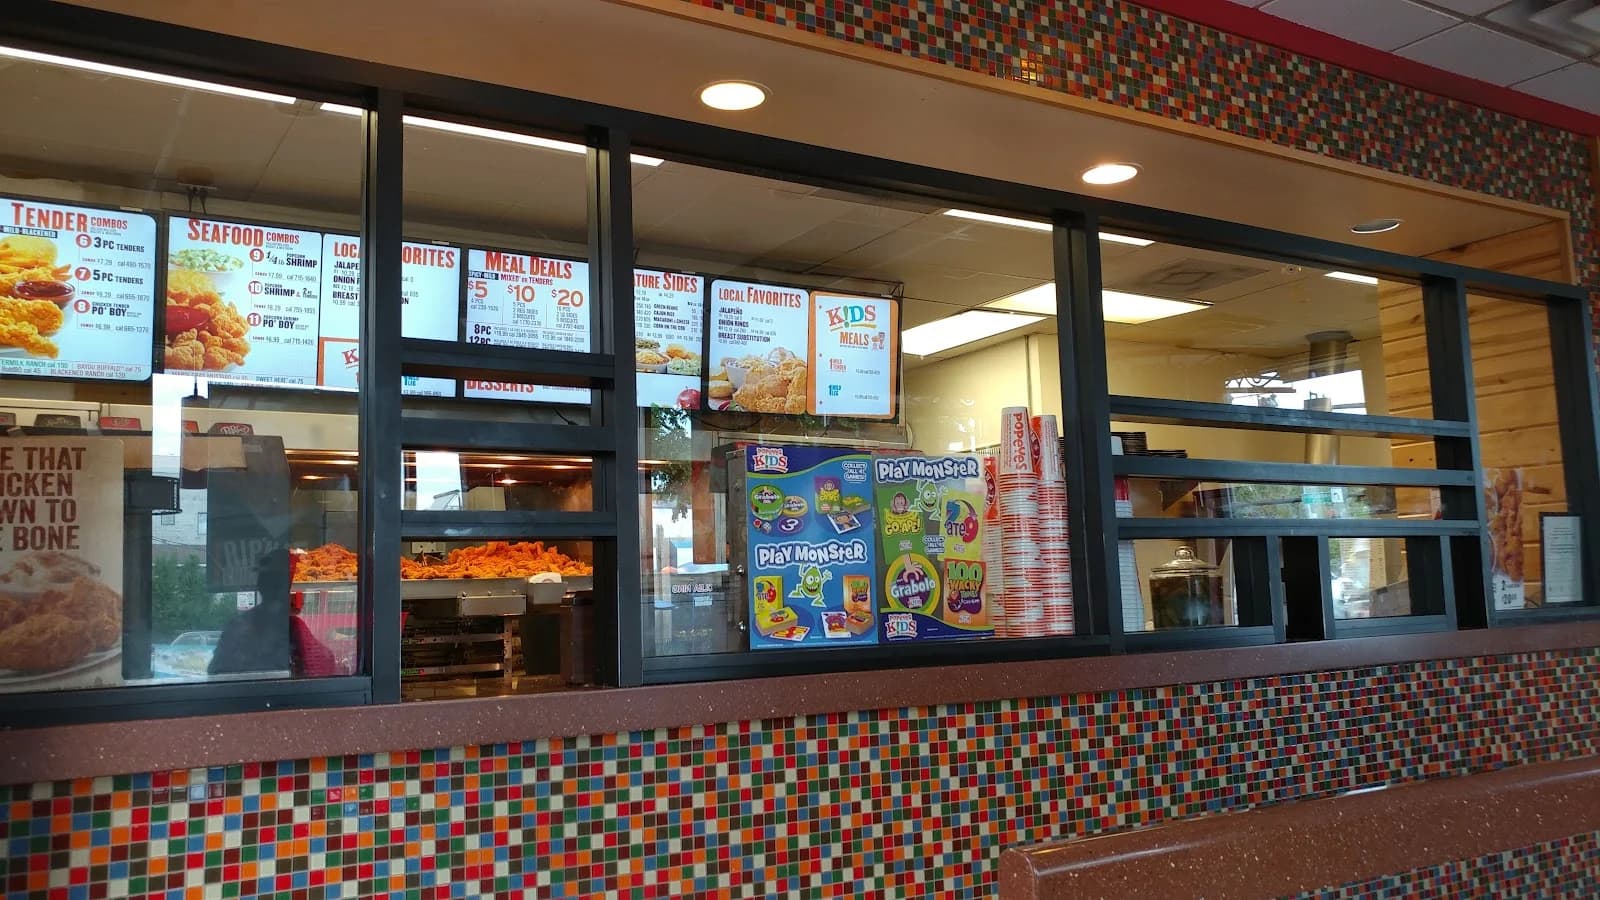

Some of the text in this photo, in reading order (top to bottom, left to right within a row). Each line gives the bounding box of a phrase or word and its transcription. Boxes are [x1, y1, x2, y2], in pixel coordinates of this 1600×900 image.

[11, 202, 88, 233] TENDER
[91, 216, 128, 230] COMBOS
[188, 218, 264, 247] SEAFOOD
[266, 231, 300, 245] COMBOS
[116, 243, 145, 253] TENDERS
[286, 257, 318, 269] SHRIMP
[485, 250, 572, 280] MEAL DEALS
[115, 276, 144, 285] TENDERS
[333, 275, 356, 285] ONION
[500, 273, 520, 282] MIXED
[529, 276, 553, 286] TENDERS
[662, 271, 698, 293] SIDES
[249, 282, 261, 294] 10
[264, 286, 295, 297] SHRIMP
[332, 291, 360, 300] BREAST
[468, 280, 584, 308] $5 $10 $20
[719, 285, 801, 308] LOCAL FAVORITES
[109, 307, 127, 317] BOY
[278, 320, 295, 330] BOY
[718, 332, 771, 342] BREAST SUBSTITUTION
[840, 331, 869, 346] MEALS
[1012, 412, 1027, 471] popeyes
[23, 447, 87, 471] THAT
[45, 499, 77, 523] TO
[13, 525, 80, 551] BONE
[947, 561, 983, 581] 100
[890, 579, 937, 598] Grabolo
[947, 580, 982, 592] WACKY
